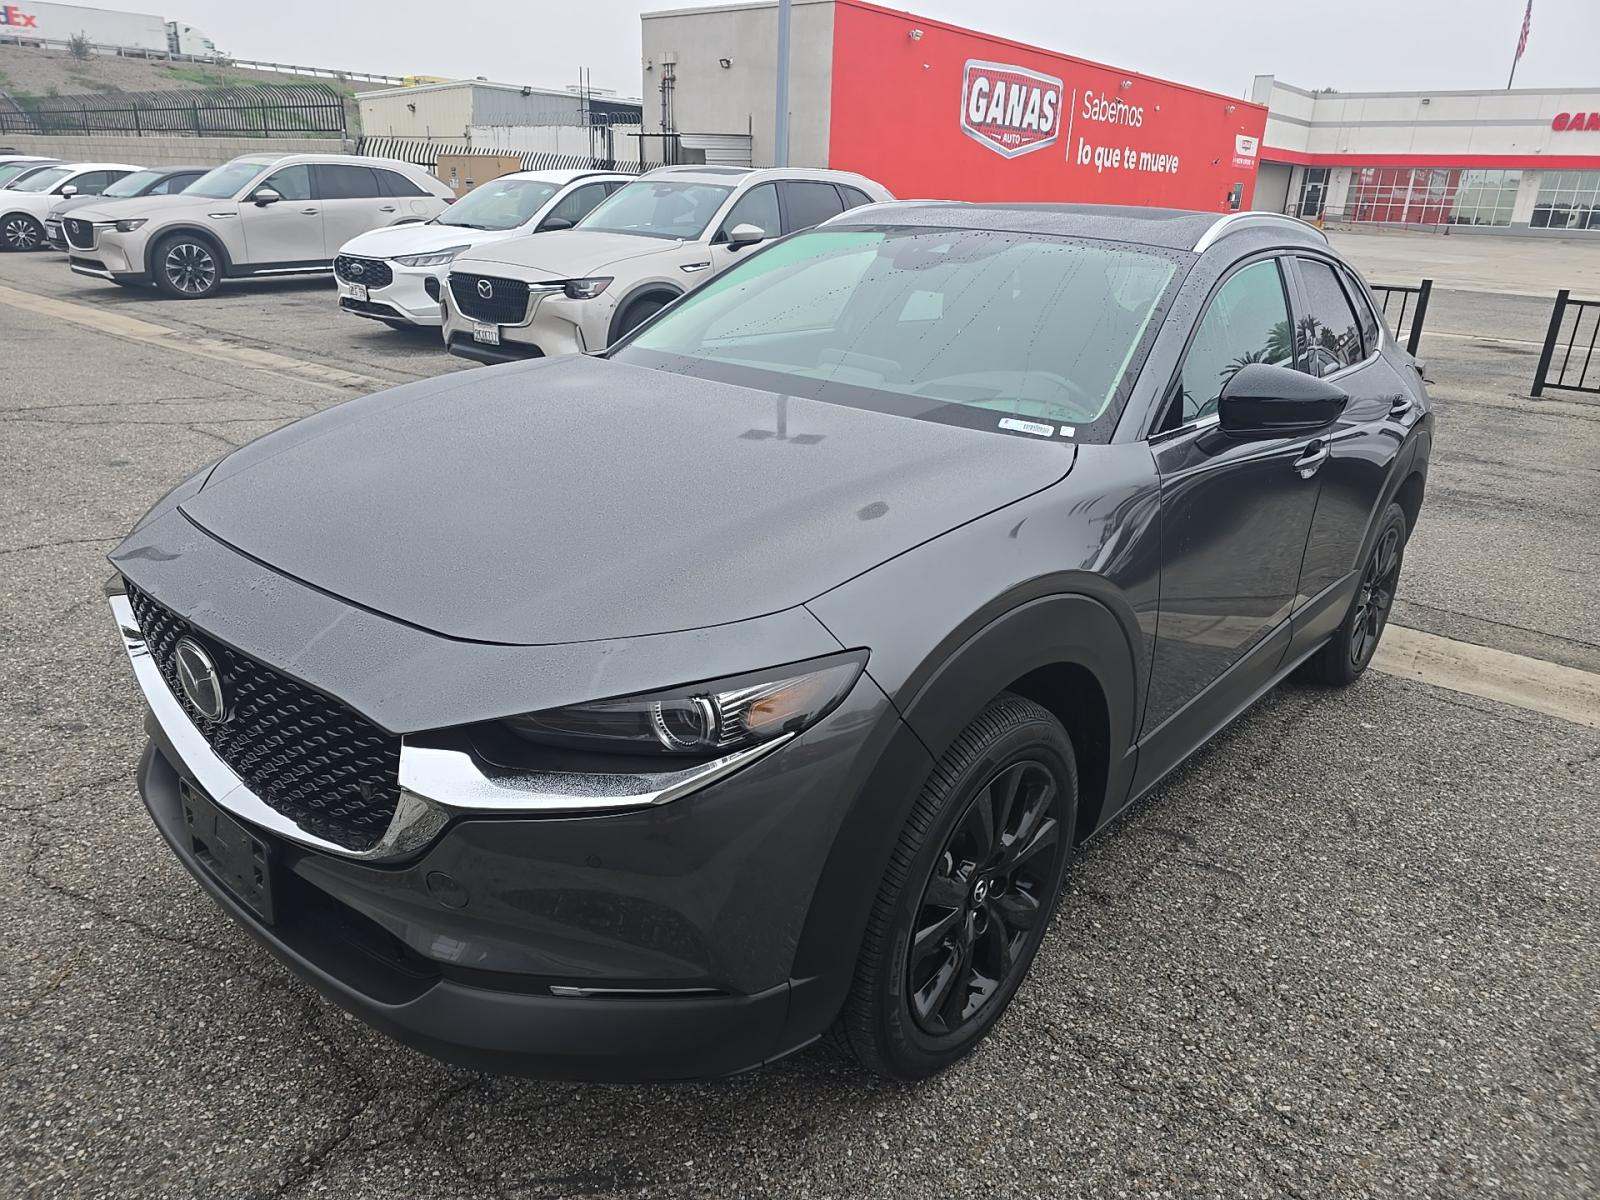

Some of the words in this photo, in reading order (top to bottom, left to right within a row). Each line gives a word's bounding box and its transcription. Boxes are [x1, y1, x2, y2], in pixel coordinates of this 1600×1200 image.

[968, 77, 1057, 133] GANAS
[1082, 90, 1144, 128] Sabemos
[1002, 133, 1021, 144] AUTO
[1077, 137, 1091, 165] lo
[1094, 150, 1121, 173] que
[1124, 147, 1137, 170] te
[1139, 152, 1179, 173] mueve
